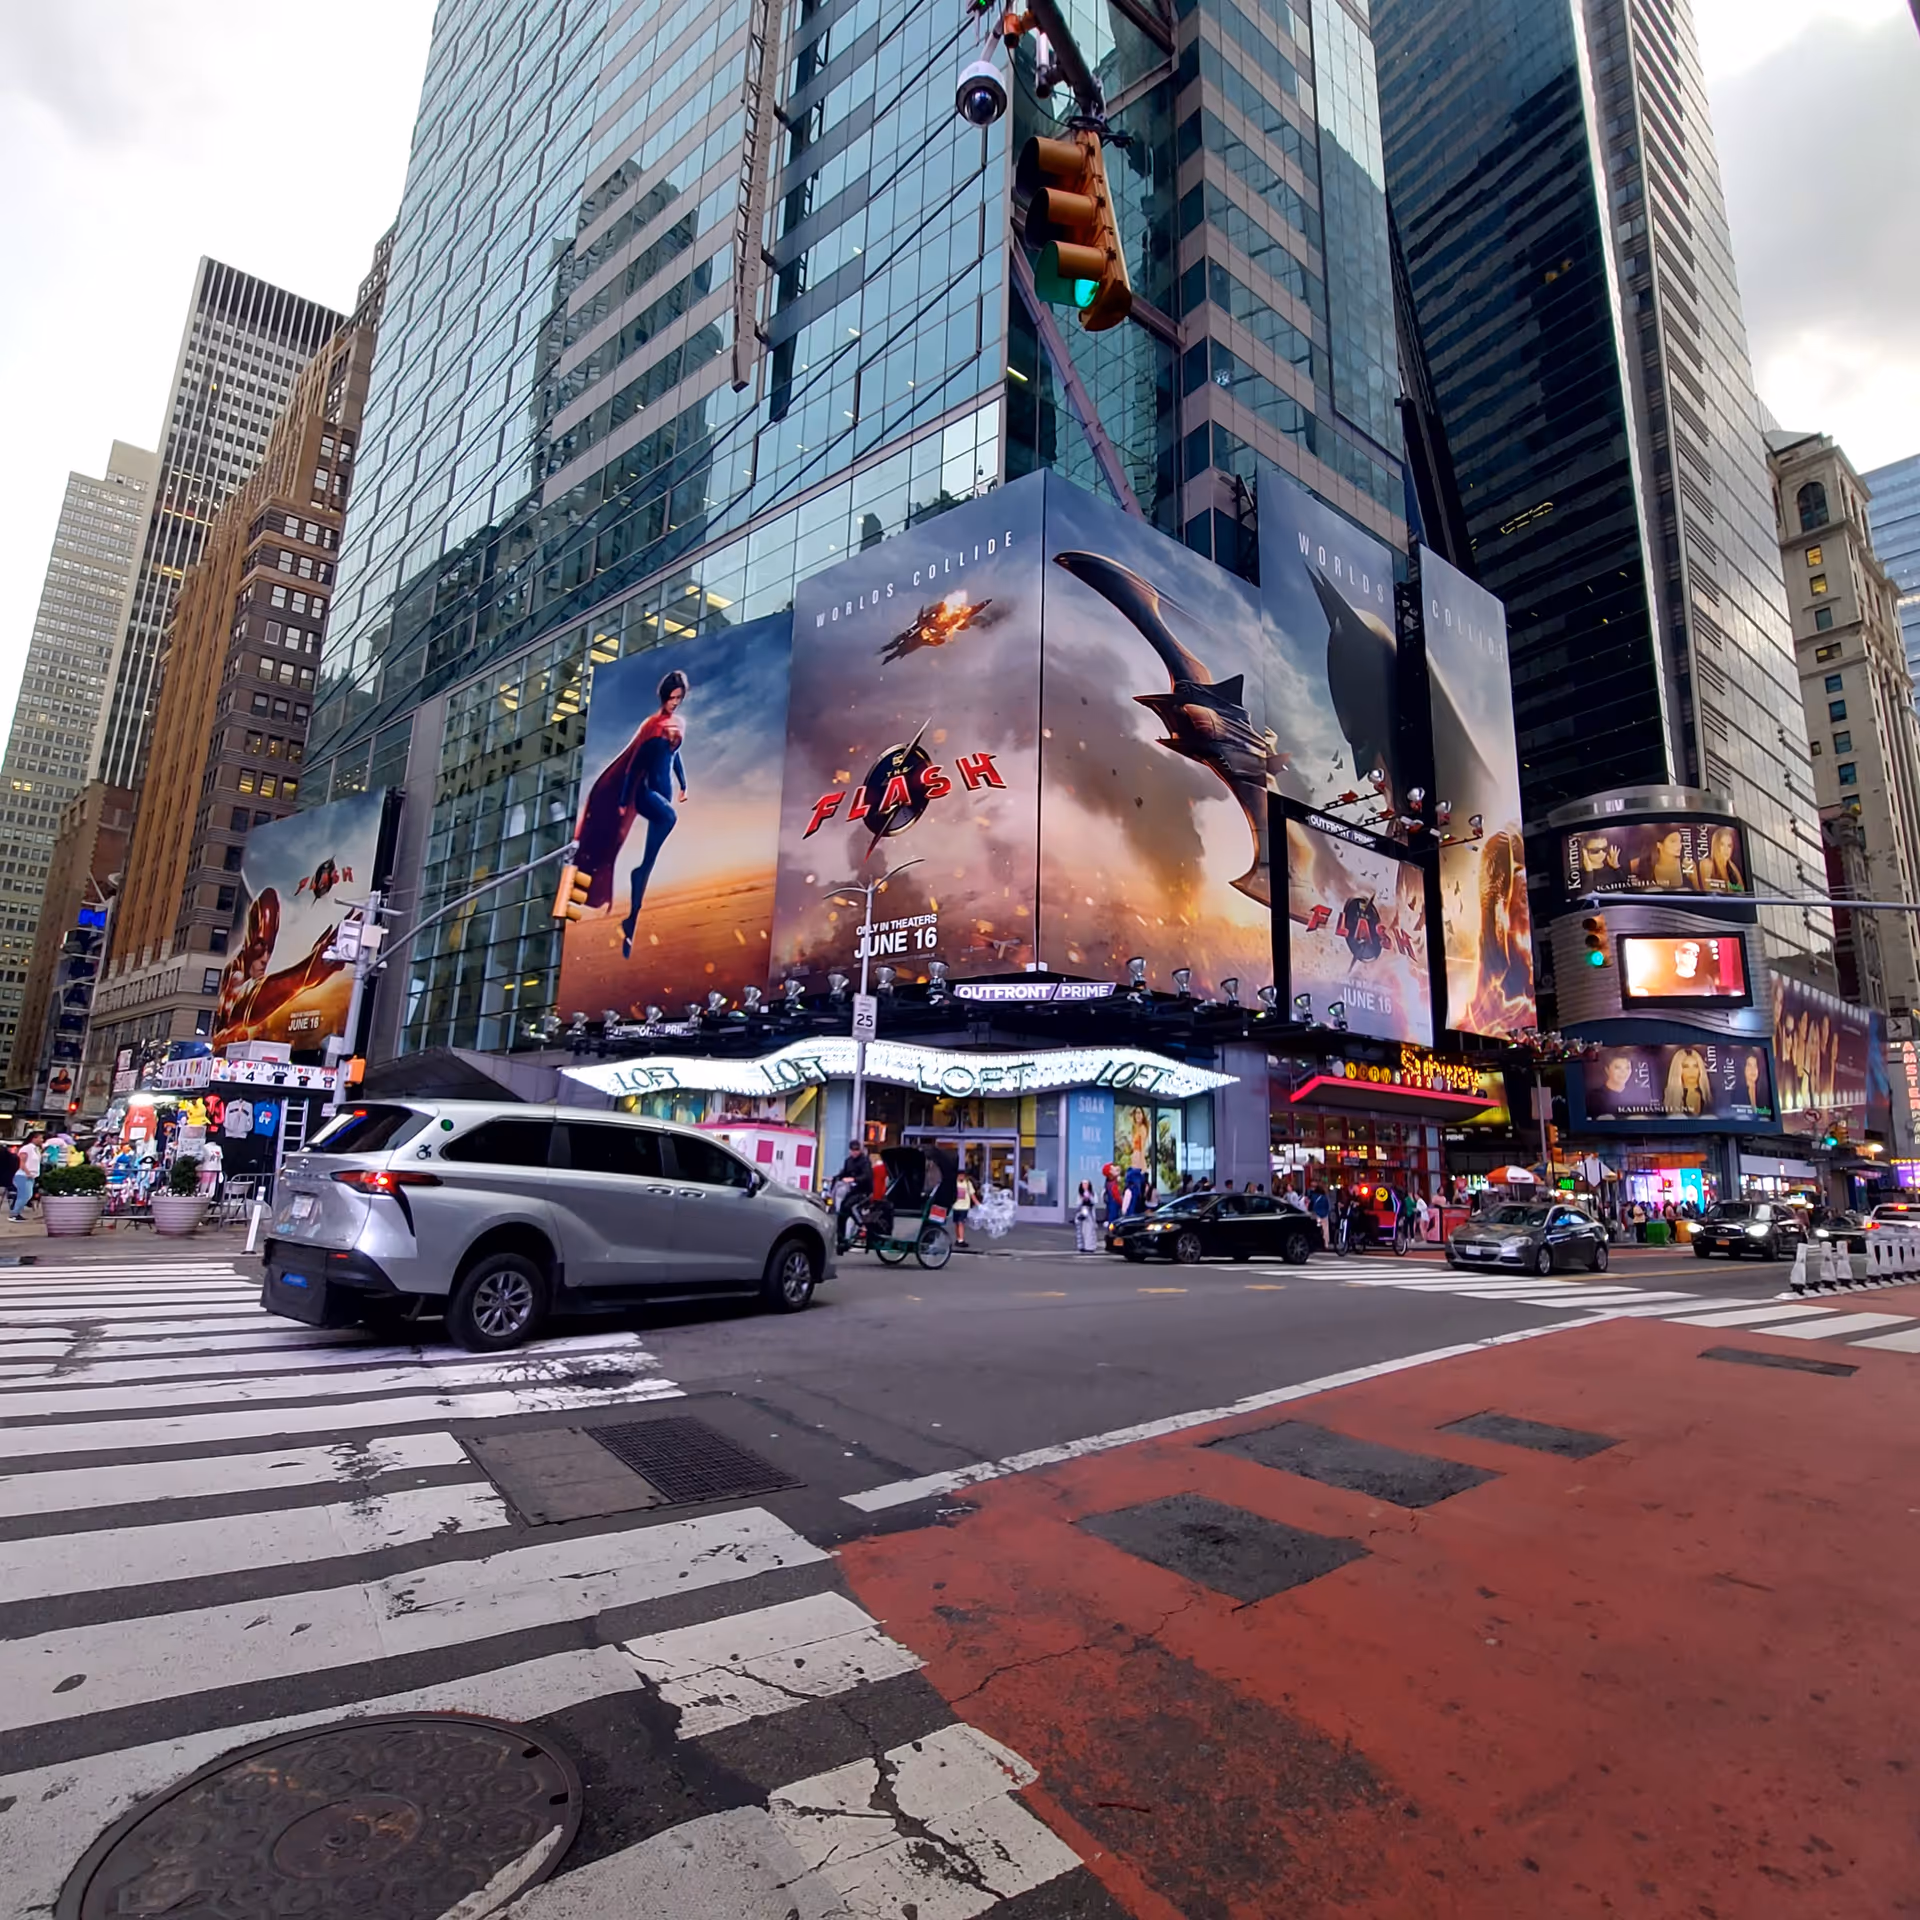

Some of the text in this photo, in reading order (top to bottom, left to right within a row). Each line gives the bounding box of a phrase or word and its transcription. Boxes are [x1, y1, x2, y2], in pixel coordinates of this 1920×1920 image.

[816, 531, 1012, 628] WORLDS COLLIDE
[1299, 532, 1384, 603] WORLDS
[1432, 599, 1504, 663] COLLIDE
[803, 753, 1007, 840] FLASH
[1568, 835, 1582, 890] Kourtney
[1680, 828, 1694, 874] Kendall
[294, 866, 354, 896] FLASH
[879, 921, 890, 932] IN
[890, 913, 938, 931] THEATERS
[1305, 904, 1418, 963] FLASH
[854, 926, 938, 959] JUNE 16
[958, 985, 1110, 999] OUTFRONT PRIME
[1339, 986, 1392, 1015] JUNE 16
[288, 1016, 320, 1031] JUNE 16
[856, 1013, 874, 1028] 25
[760, 1056, 828, 1089] LOFT
[1400, 1049, 1479, 1095] Subway
[1705, 1045, 1718, 1073] Kim
[1723, 1057, 1737, 1091] Kylie
[613, 1067, 680, 1091] LOFT
[917, 1062, 1036, 1098] LOFT
[1096, 1059, 1175, 1093] LOFT
[1078, 1096, 1105, 1114] SOAK
[1082, 1125, 1101, 1142] MIX
